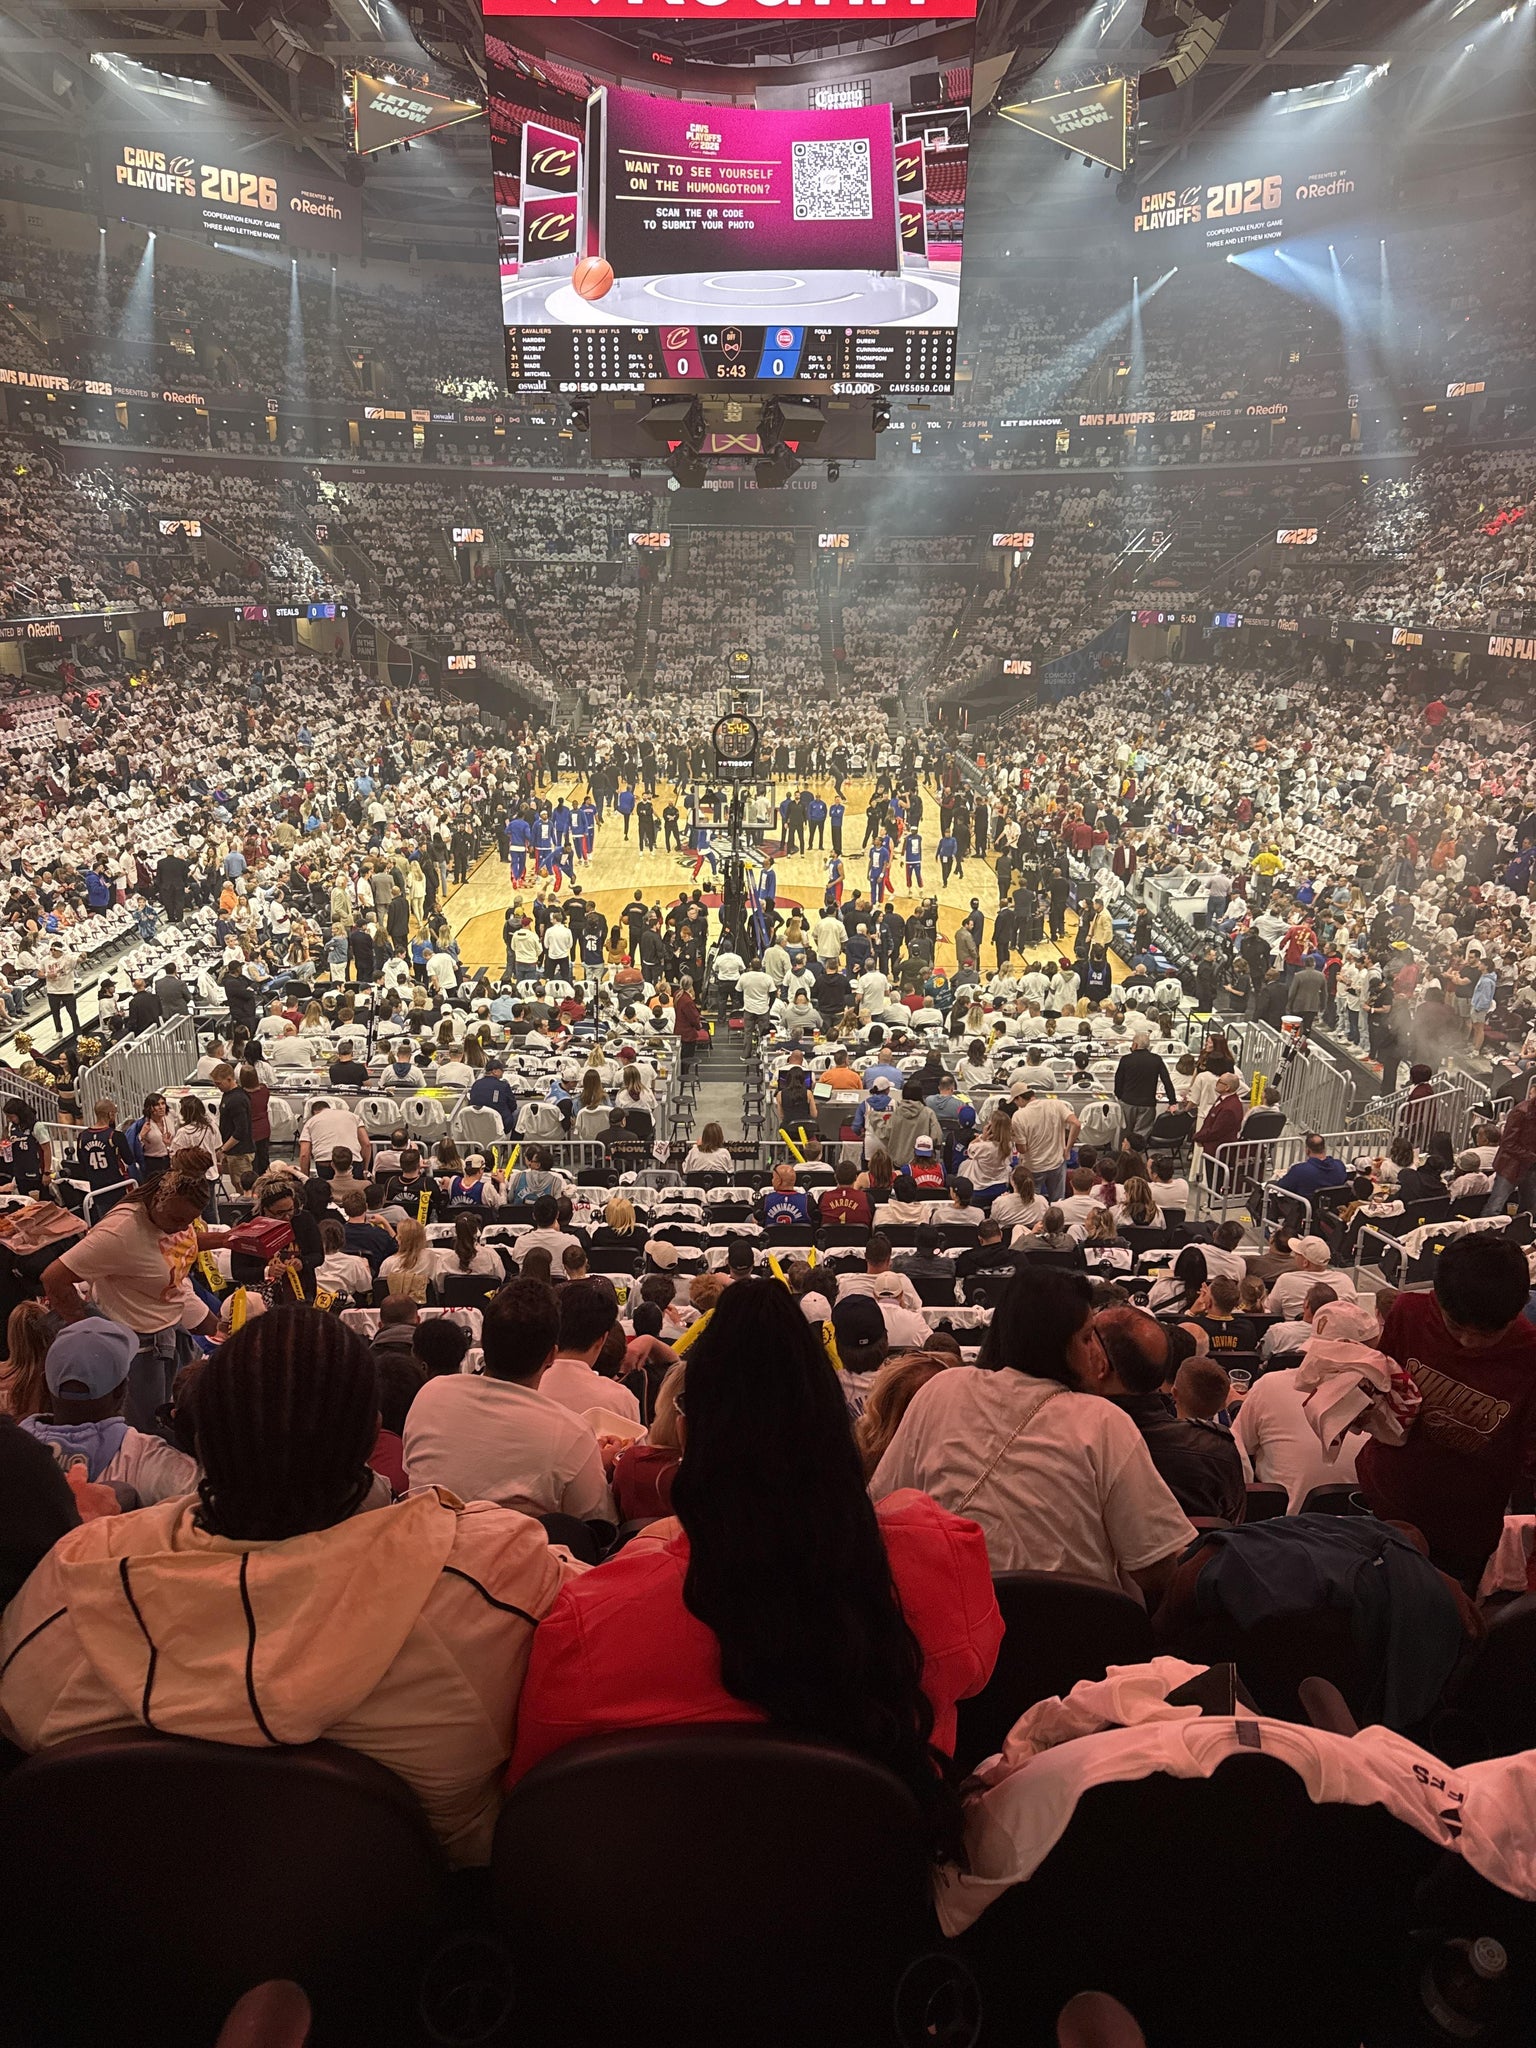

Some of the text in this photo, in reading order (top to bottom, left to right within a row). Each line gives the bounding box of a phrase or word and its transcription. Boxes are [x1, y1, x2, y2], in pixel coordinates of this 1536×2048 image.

[376, 92, 433, 114] LET EM
[369, 101, 427, 124] KNOW.
[1049, 102, 1104, 125] LET EM
[690, 123, 709, 133] CAVS
[1056, 112, 1114, 134] KNOW.
[686, 131, 722, 142] PLAYOFFS
[124, 146, 165, 172] CAVS
[625, 160, 773, 179] WANT TO SEE YOURSELF
[116, 165, 196, 197] PLAYOFFS
[200, 165, 278, 211] 2026
[630, 178, 770, 194] ON THE HUMONGOTRON?
[1309, 179, 1354, 199] Redfin
[1141, 190, 1176, 212] CAVS
[1206, 175, 1282, 219] 2026
[302, 199, 342, 220] Redfin
[656, 208, 744, 218] SCAN THE QR CODE
[265, 221, 280, 229] GAME
[644, 220, 754, 229] TO SUBMIT YOUR PHOTO
[1134, 205, 1201, 232] PLAYOFFS
[1267, 219, 1283, 228] GAME
[203, 222, 280, 240] THREE AND KNOW
[1225, 237, 1236, 246] AND
[1264, 232, 1282, 240] KNOW
[703, 334, 717, 344] 1Q
[677, 358, 688, 374] 0
[717, 365, 746, 377] 5:43
[772, 359, 784, 375] 0
[18, 372, 70, 391] PLAYOFFS
[85, 380, 112, 396] 2026
[114, 388, 148, 398] PRESENTED
[172, 393, 205, 405] Redfin
[518, 380, 546, 390] oswald
[601, 383, 645, 391] RAFFLE
[833, 383, 950, 395] $10,000 CAVS5050.COM
[464, 415, 486, 423] $10,000
[1079, 414, 1104, 426] CAVS
[1106, 412, 1155, 425] PLAYOFFS
[1170, 409, 1196, 422] 2026
[1197, 409, 1231, 417] PRESENTED
[1255, 403, 1288, 415] Redfin
[791, 481, 817, 490] CLUB
[452, 528, 484, 543] CAVS
[649, 533, 670, 547] 26
[818, 534, 849, 548] CAVS
[1012, 533, 1034, 547] 26
[262, 609, 267, 618] 0
[276, 608, 299, 616] STEALS
[312, 608, 316, 616] 0
[1158, 613, 1163, 623] 0
[1180, 614, 1196, 623] 5:43
[1215, 616, 1219, 625] 0
[1244, 618, 1269, 626] PRESENTED
[17, 628, 24, 636] BY
[35, 623, 60, 638] Redfin
[1488, 636, 1512, 656] CAVS
[448, 655, 476, 670] CAVS
[1003, 660, 1032, 675] CAVS
[728, 723, 749, 734] 5:42
[586, 940, 596, 951] 45
[19, 1142, 28, 1150] 45
[89, 1152, 108, 1170] 45
[768, 1203, 802, 1219] CUNNINGHAM
[830, 1199, 859, 1210] HARDEN
[839, 1212, 846, 1224] 1
[1212, 1336, 1238, 1348] IRVING
